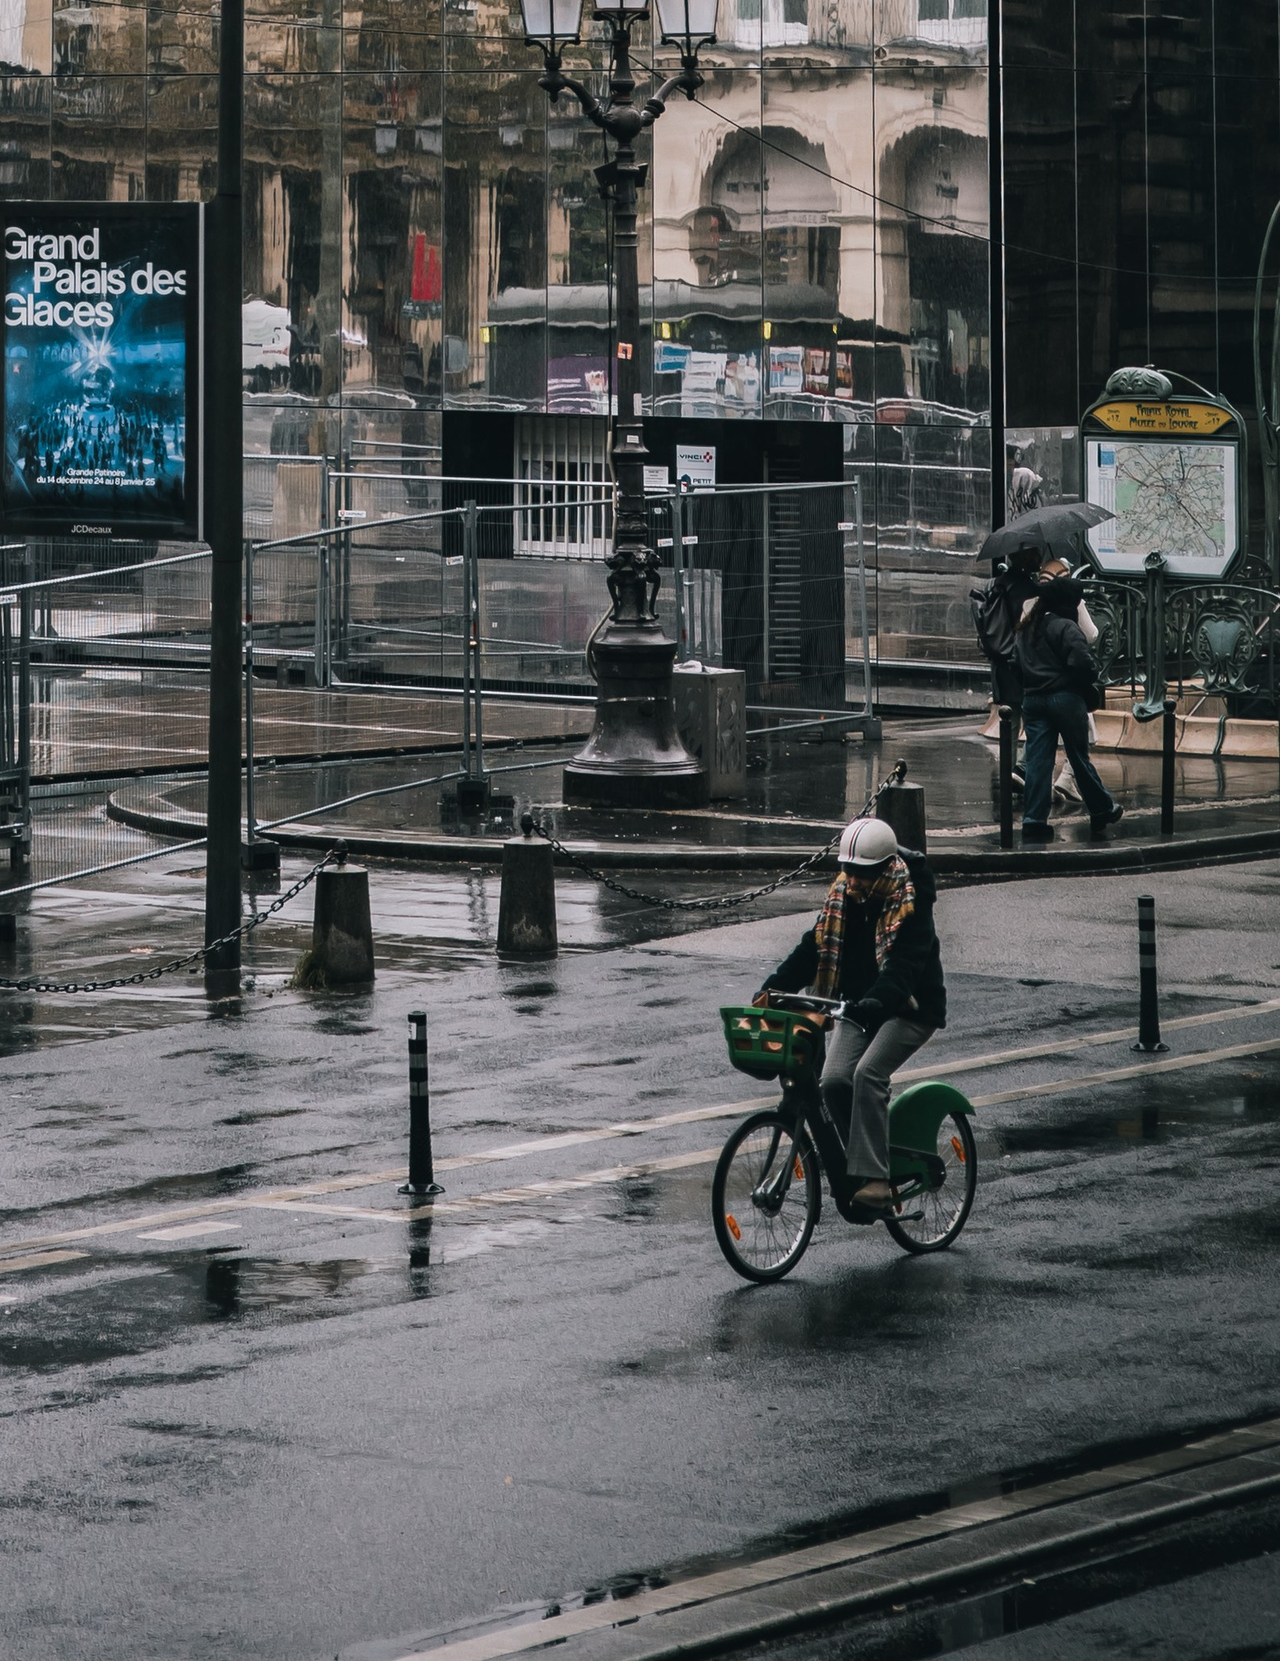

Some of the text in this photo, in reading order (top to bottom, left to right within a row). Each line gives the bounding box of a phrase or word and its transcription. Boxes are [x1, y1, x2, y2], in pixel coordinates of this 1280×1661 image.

[5, 226, 99, 260] Grand
[33, 261, 187, 295] Palais des
[5, 292, 114, 327] Glaces
[36, 476, 156, 487] du 14 décembre 24 au 8 janvier 25
[67, 468, 126, 477] Grande Patinoire
[71, 524, 112, 534] JCDecaux
